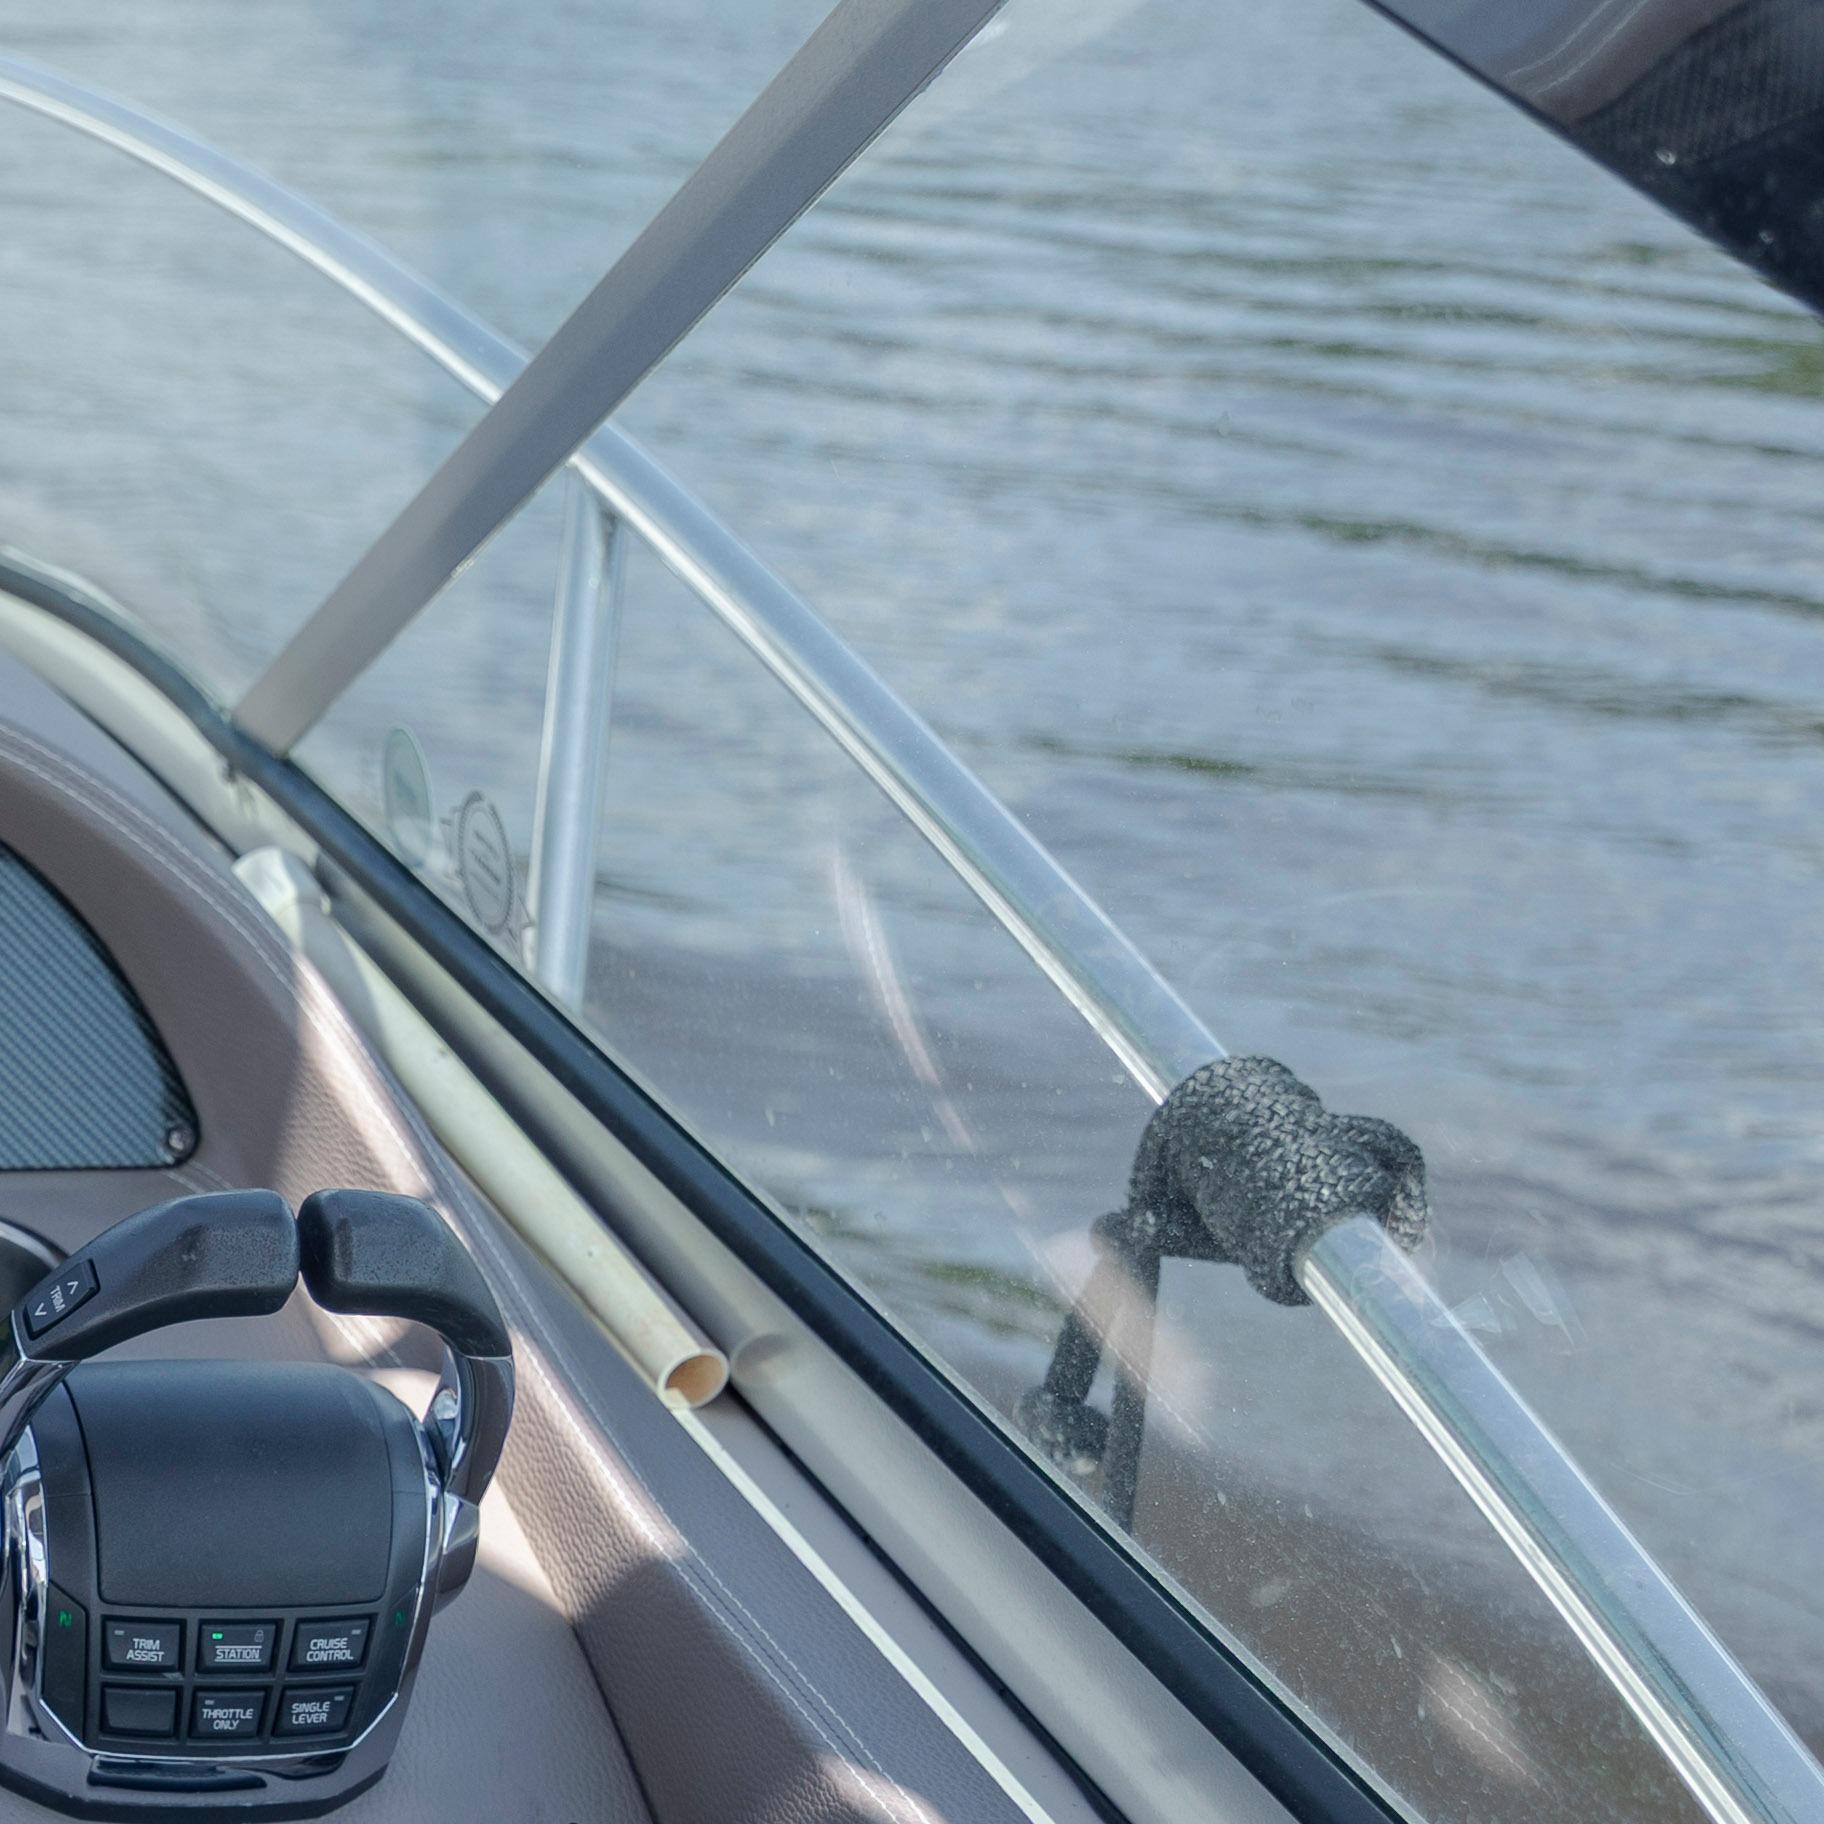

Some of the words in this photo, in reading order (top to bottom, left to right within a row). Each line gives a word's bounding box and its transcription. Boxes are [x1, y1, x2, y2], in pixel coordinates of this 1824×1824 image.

[49, 1284, 66, 1313] TRIM
[132, 1637, 160, 1651] TRIM
[309, 1637, 349, 1652] CRUISE
[125, 1649, 165, 1664] ASSIST
[215, 1647, 261, 1661] STATION
[305, 1649, 354, 1664] CONTROL
[201, 1708, 255, 1721] THROTTLE
[291, 1701, 331, 1715] SINGLE
[212, 1719, 240, 1732] ONLY
[292, 1712, 328, 1726] LEVER
